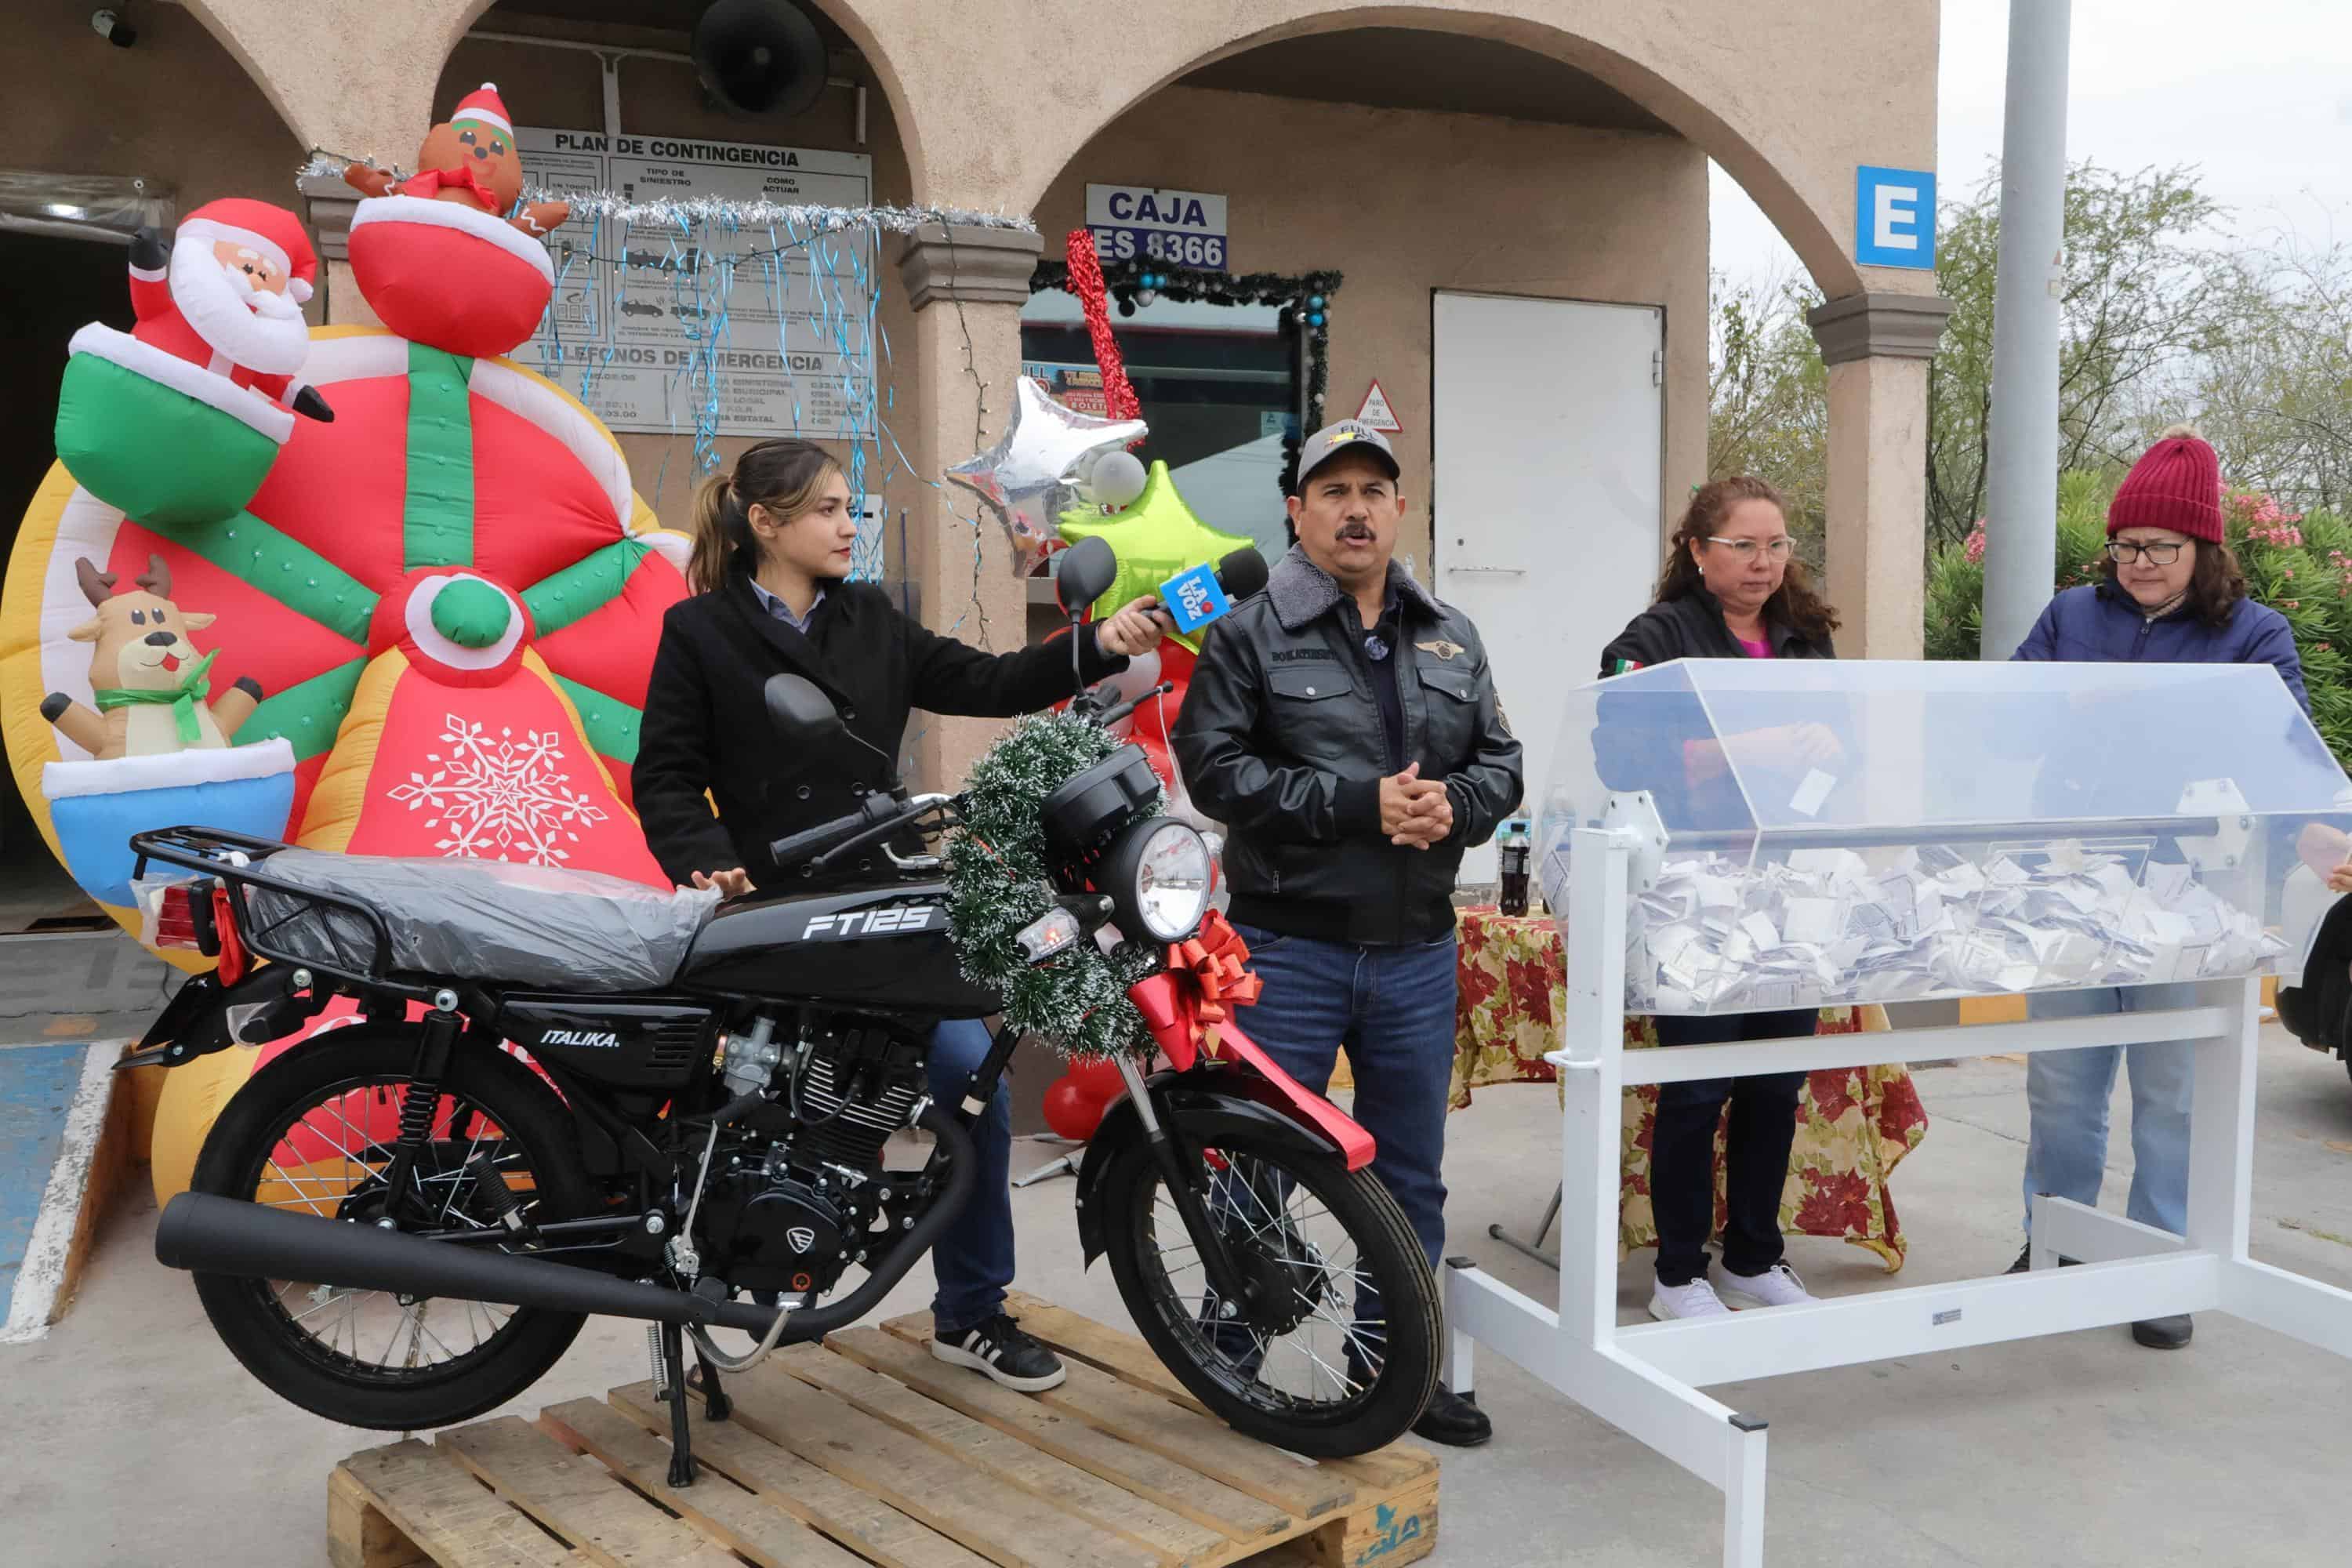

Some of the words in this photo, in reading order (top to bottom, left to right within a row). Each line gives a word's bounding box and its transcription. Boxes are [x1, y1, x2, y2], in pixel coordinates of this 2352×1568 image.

[555, 134, 609, 152] PLAN
[617, 139, 644, 154] DE
[650, 141, 799, 167] CONTINGENCIA
[640, 176, 691, 187] SINIESTRO
[1109, 192, 1207, 227] CAJA
[1874, 184, 1918, 250] E
[1094, 228, 1135, 259] ES
[1146, 232, 1223, 266] 8366
[663, 350, 691, 365] DE
[1177, 583, 1203, 622] VOZ
[1187, 575, 1208, 604] LA
[802, 906, 935, 940] FT125
